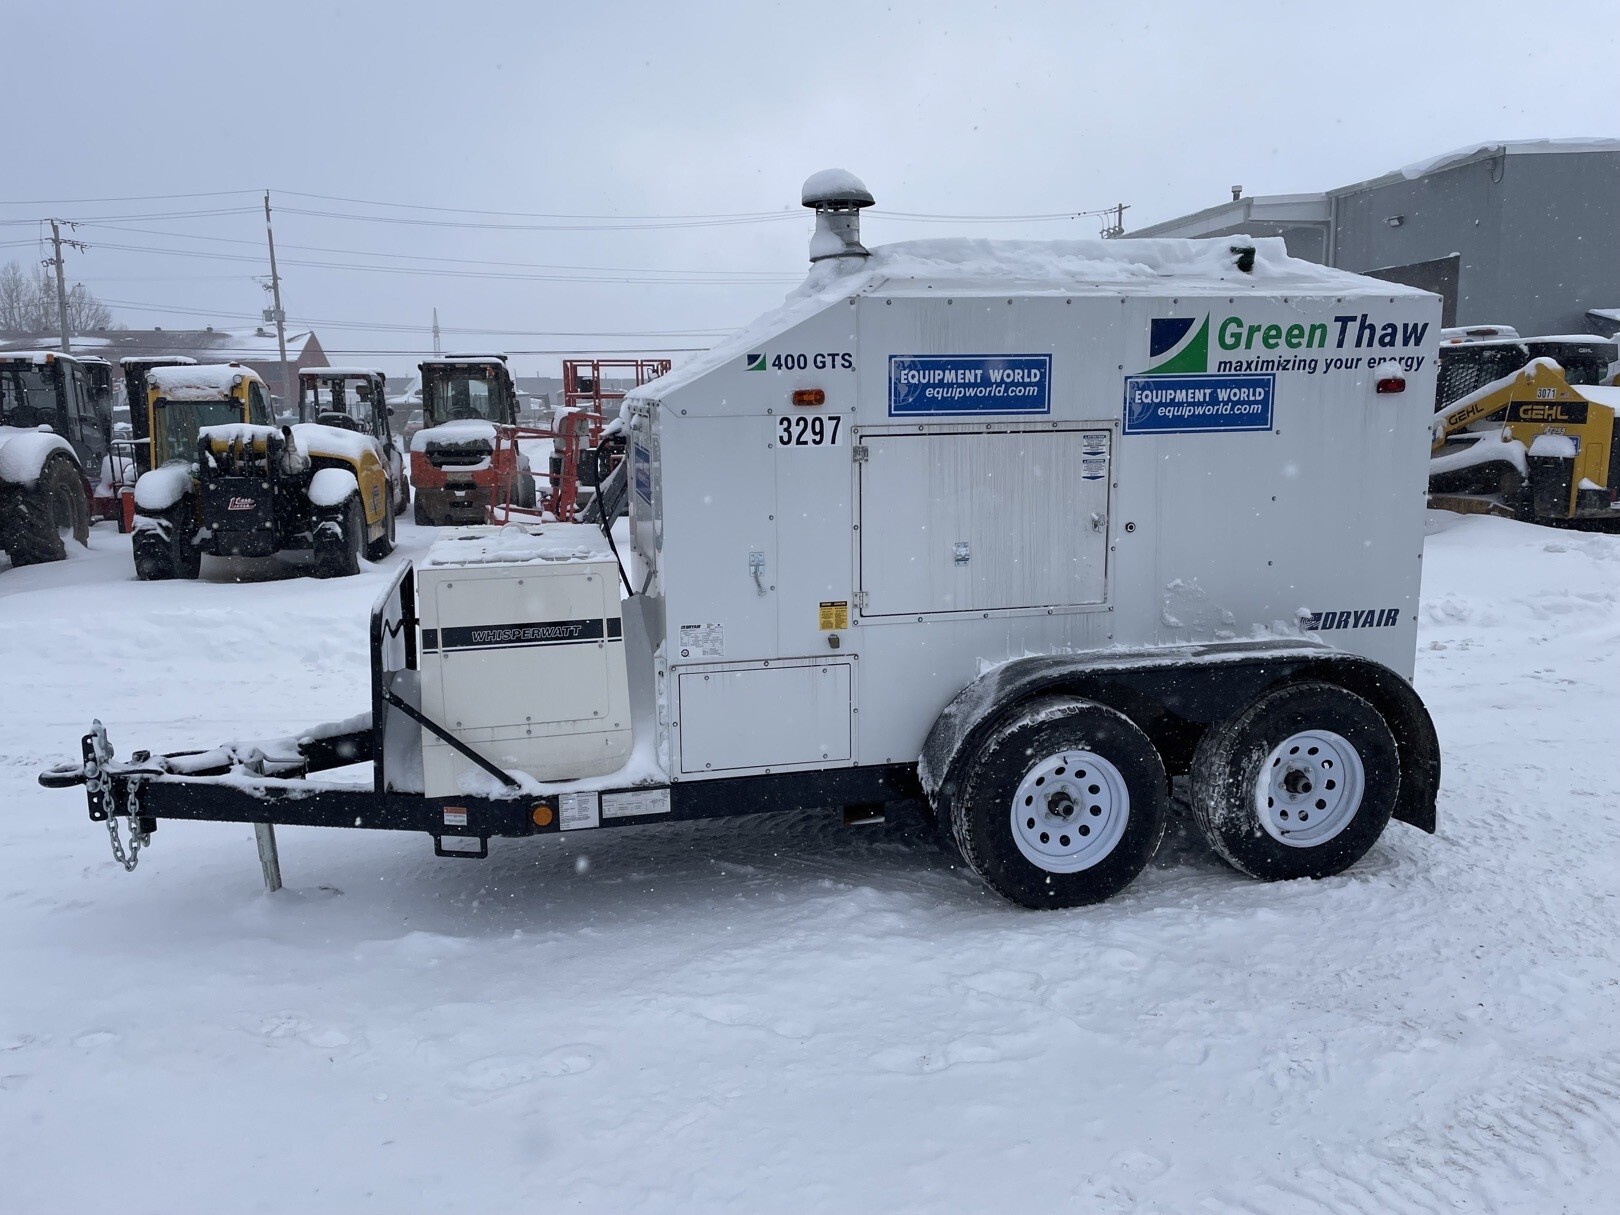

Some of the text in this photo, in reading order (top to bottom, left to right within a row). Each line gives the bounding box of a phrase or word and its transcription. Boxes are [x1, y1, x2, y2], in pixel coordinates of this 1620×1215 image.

[772, 352, 853, 370] 400 GTS
[1217, 355, 1317, 374] maximizing
[1323, 357, 1362, 374] your
[900, 369, 983, 384] EQUIPMENT
[925, 384, 1038, 400] equipworld.com
[1134, 388, 1212, 403] EQUIPMENT
[1537, 388, 1556, 398] 3071
[1157, 403, 1262, 418] equipworld.com
[1448, 403, 1485, 426] GEHL
[1520, 404, 1569, 420] GEHL
[778, 415, 842, 446] 3297
[1321, 608, 1400, 630] DRYAIR
[472, 625, 582, 643] WHISPERWATT
